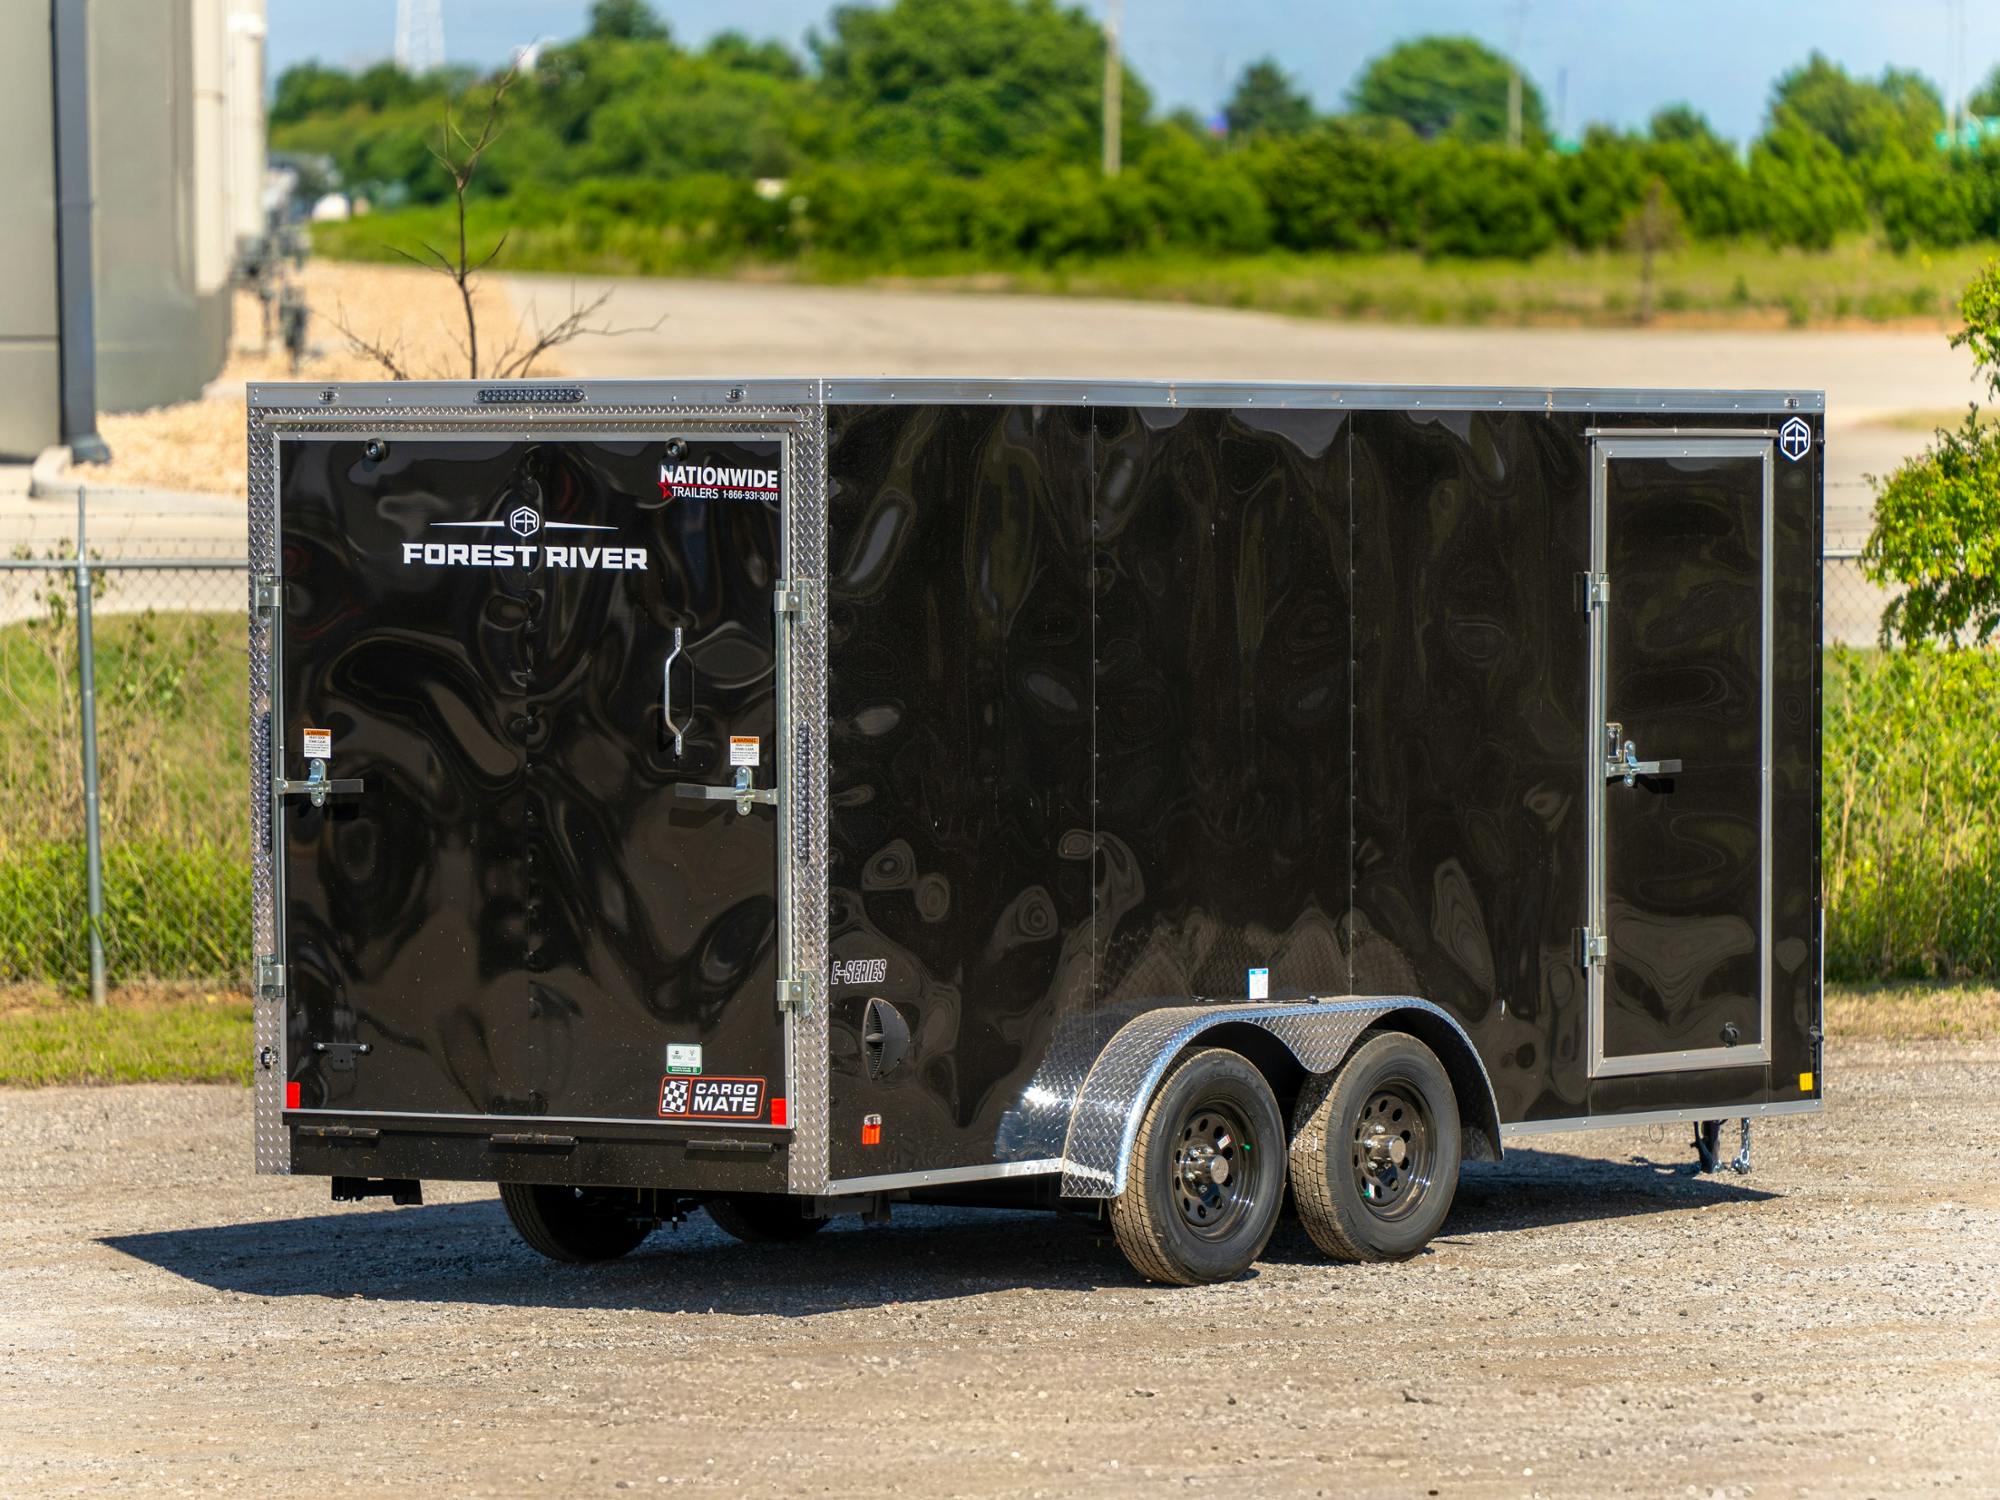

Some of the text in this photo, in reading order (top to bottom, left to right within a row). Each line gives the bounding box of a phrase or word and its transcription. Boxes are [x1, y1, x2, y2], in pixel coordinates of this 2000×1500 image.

[660, 465, 778, 488] NATIONWIDE
[672, 486, 778, 501] TRAILERS 1-866-931-3001
[402, 543, 648, 570] FOREST RIVER
[831, 959, 887, 985] E-SERIES
[695, 1083, 758, 1096] CARGO
[693, 1096, 757, 1112] MATE
